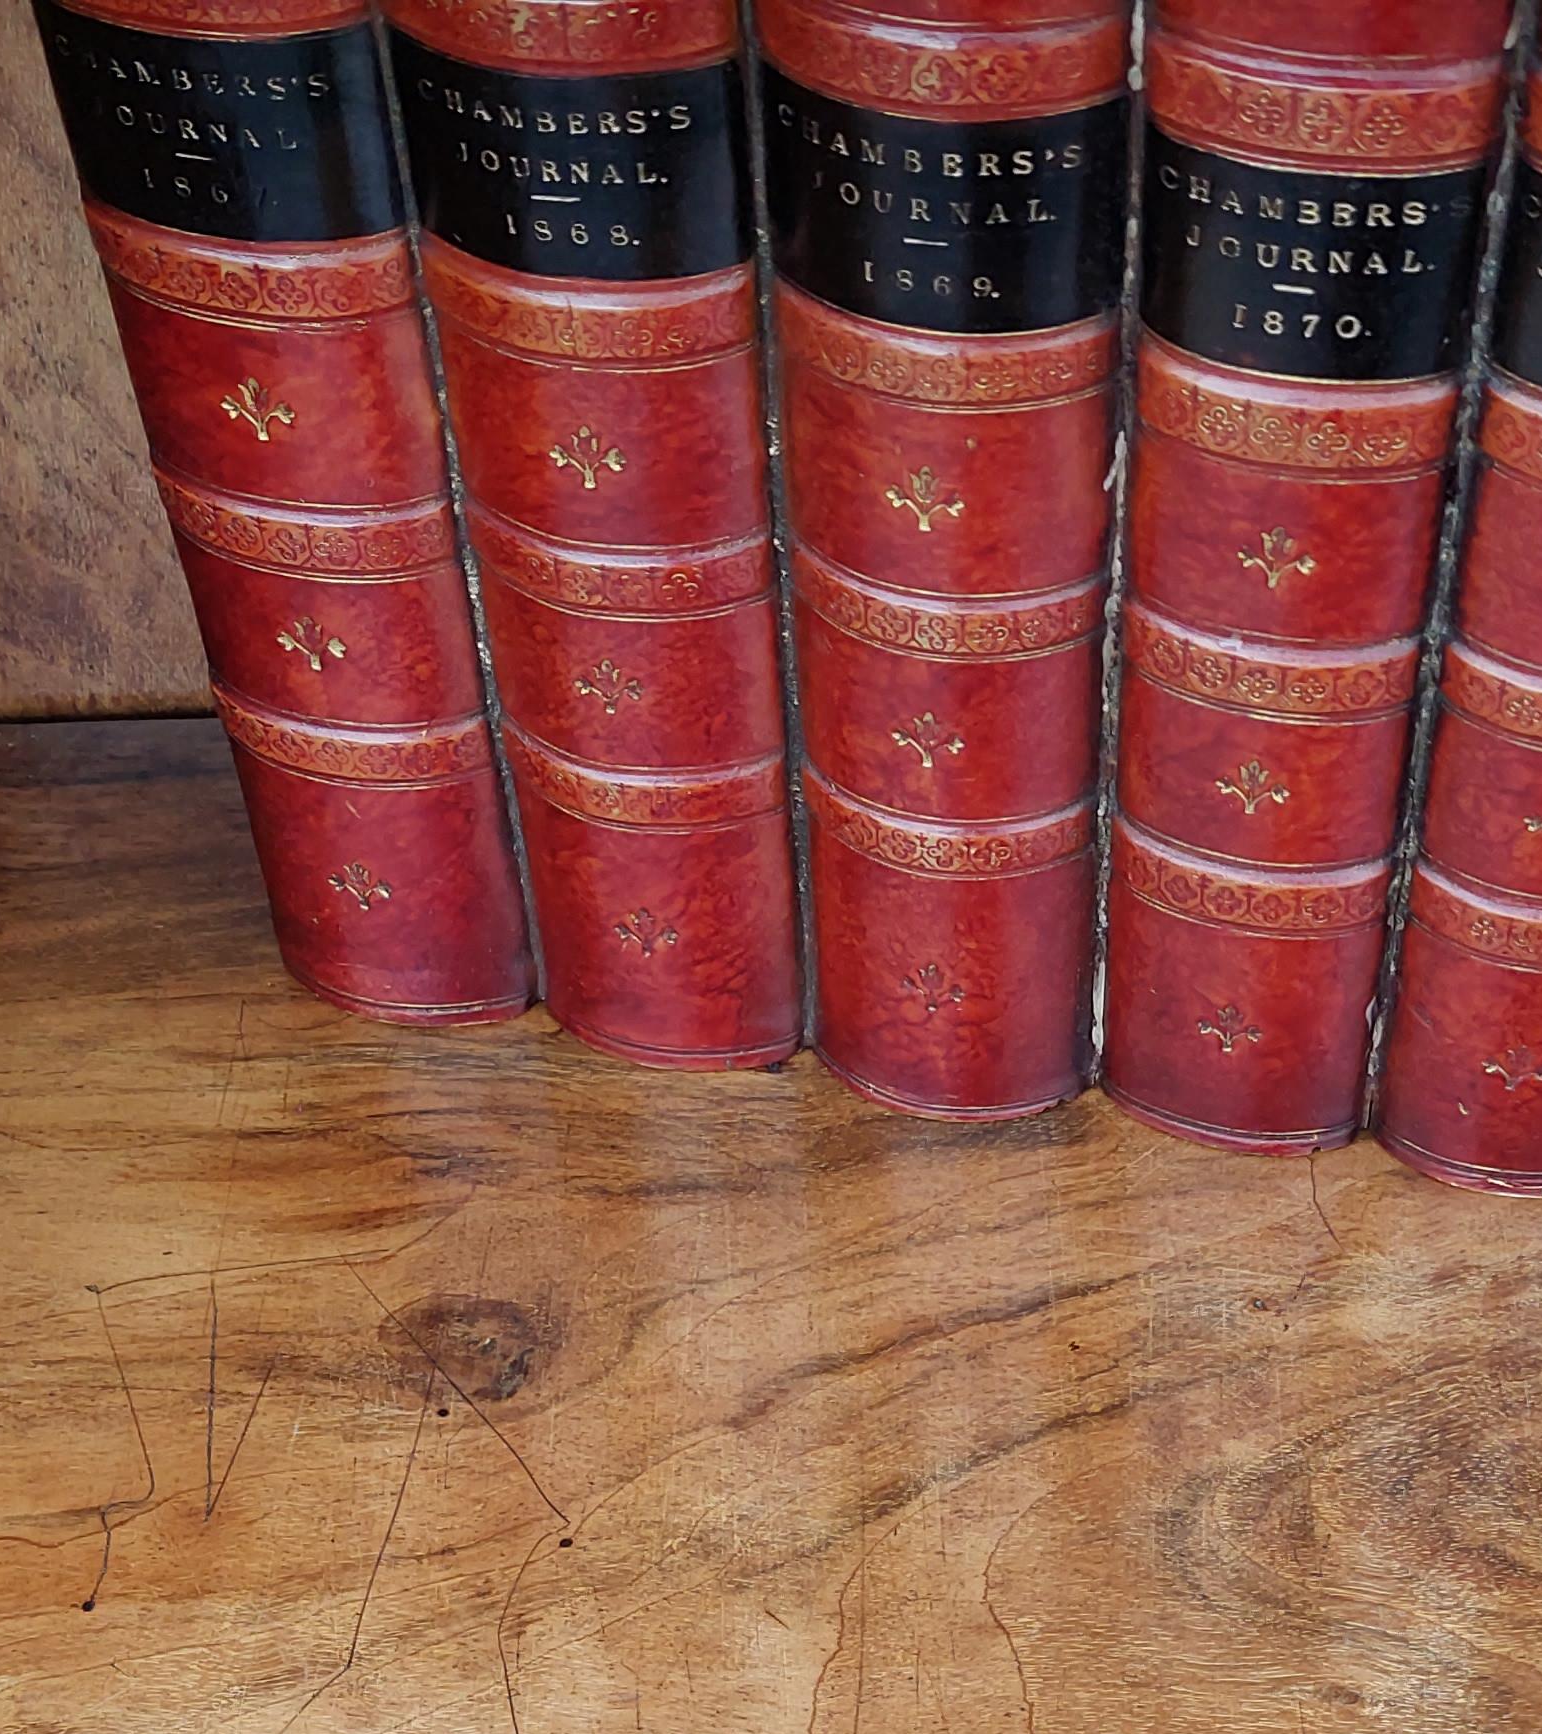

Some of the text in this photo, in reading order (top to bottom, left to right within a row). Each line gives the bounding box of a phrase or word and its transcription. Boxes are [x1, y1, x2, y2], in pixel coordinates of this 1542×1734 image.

[95, 98, 297, 150] OURNAL
[417, 78, 691, 135] CHAMBERS'S
[456, 141, 670, 185] JOURNAL.
[777, 103, 1083, 177] CHAMBERS'S
[142, 167, 280, 208] 186.
[811, 170, 1057, 225] JOURNAL.
[505, 213, 641, 246] 1868.
[1185, 224, 1437, 275] JOURNAL.
[862, 260, 1002, 299] 1869.
[1232, 303, 1373, 339] 1870.
